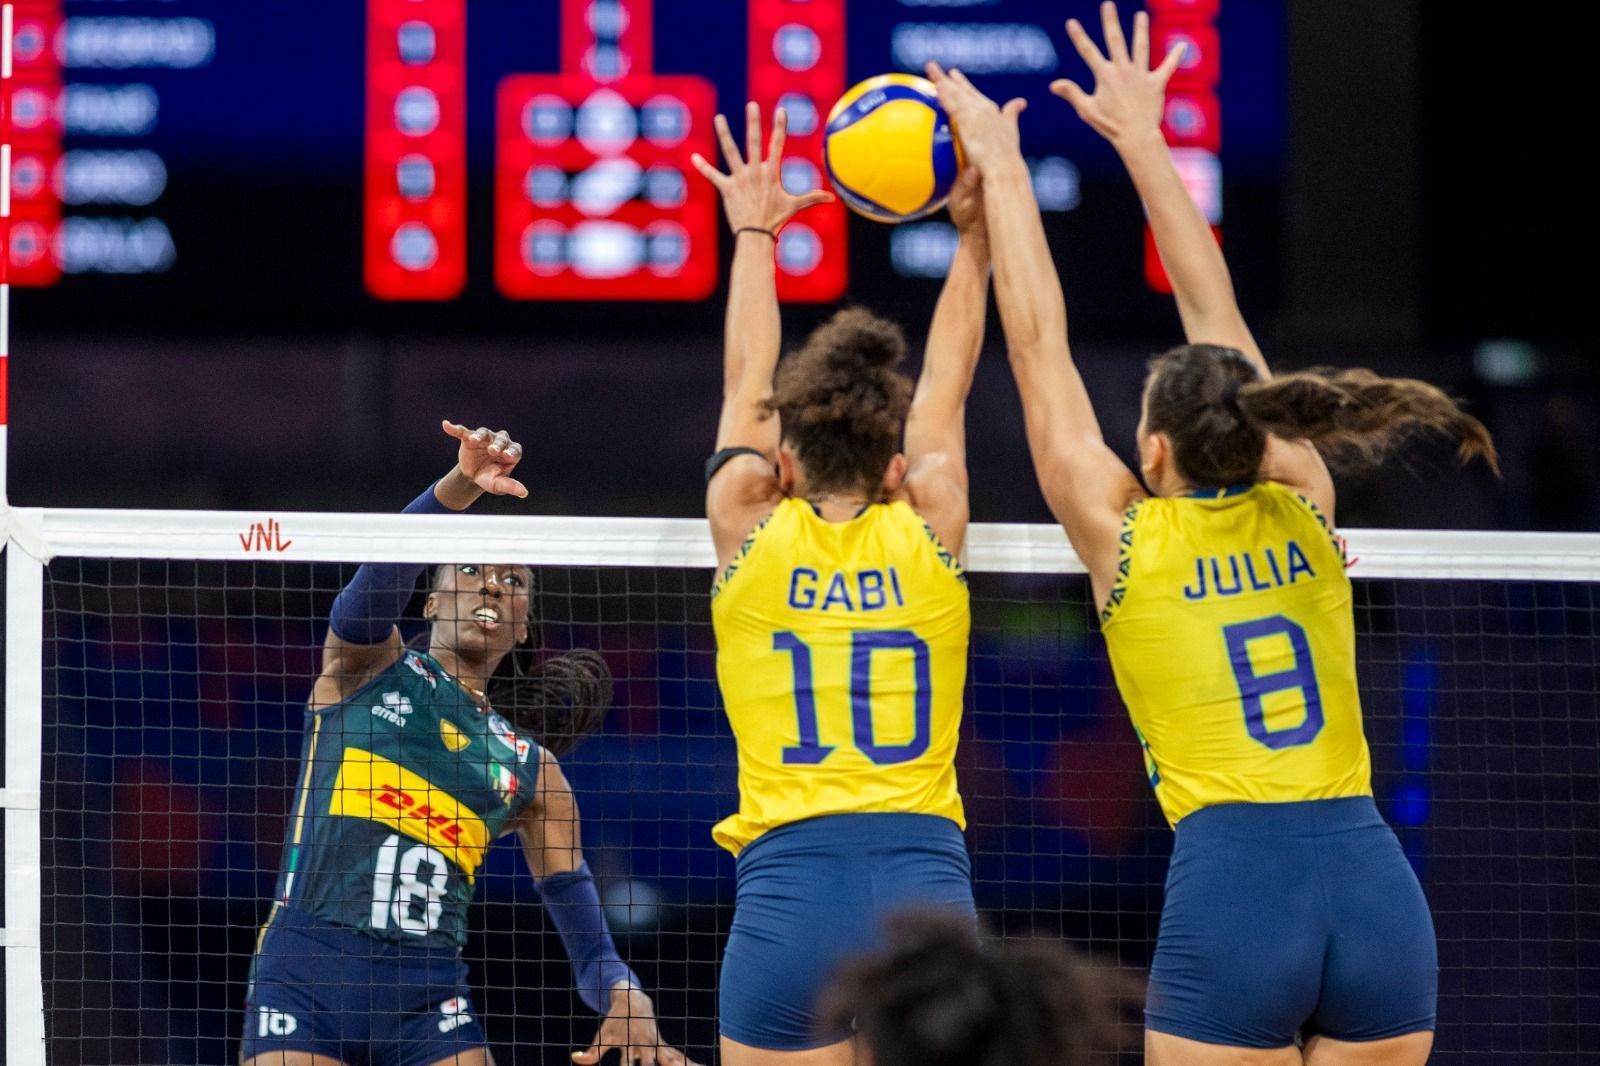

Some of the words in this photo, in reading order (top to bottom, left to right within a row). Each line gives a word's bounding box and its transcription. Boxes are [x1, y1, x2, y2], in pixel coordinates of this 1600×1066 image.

[239, 518, 292, 552] VNL
[789, 566, 904, 612] GABI
[1184, 541, 1316, 600] JULIA
[773, 630, 932, 765] 10
[1223, 614, 1325, 751] 8
[377, 784, 464, 846] DHL
[369, 833, 449, 936] 18
